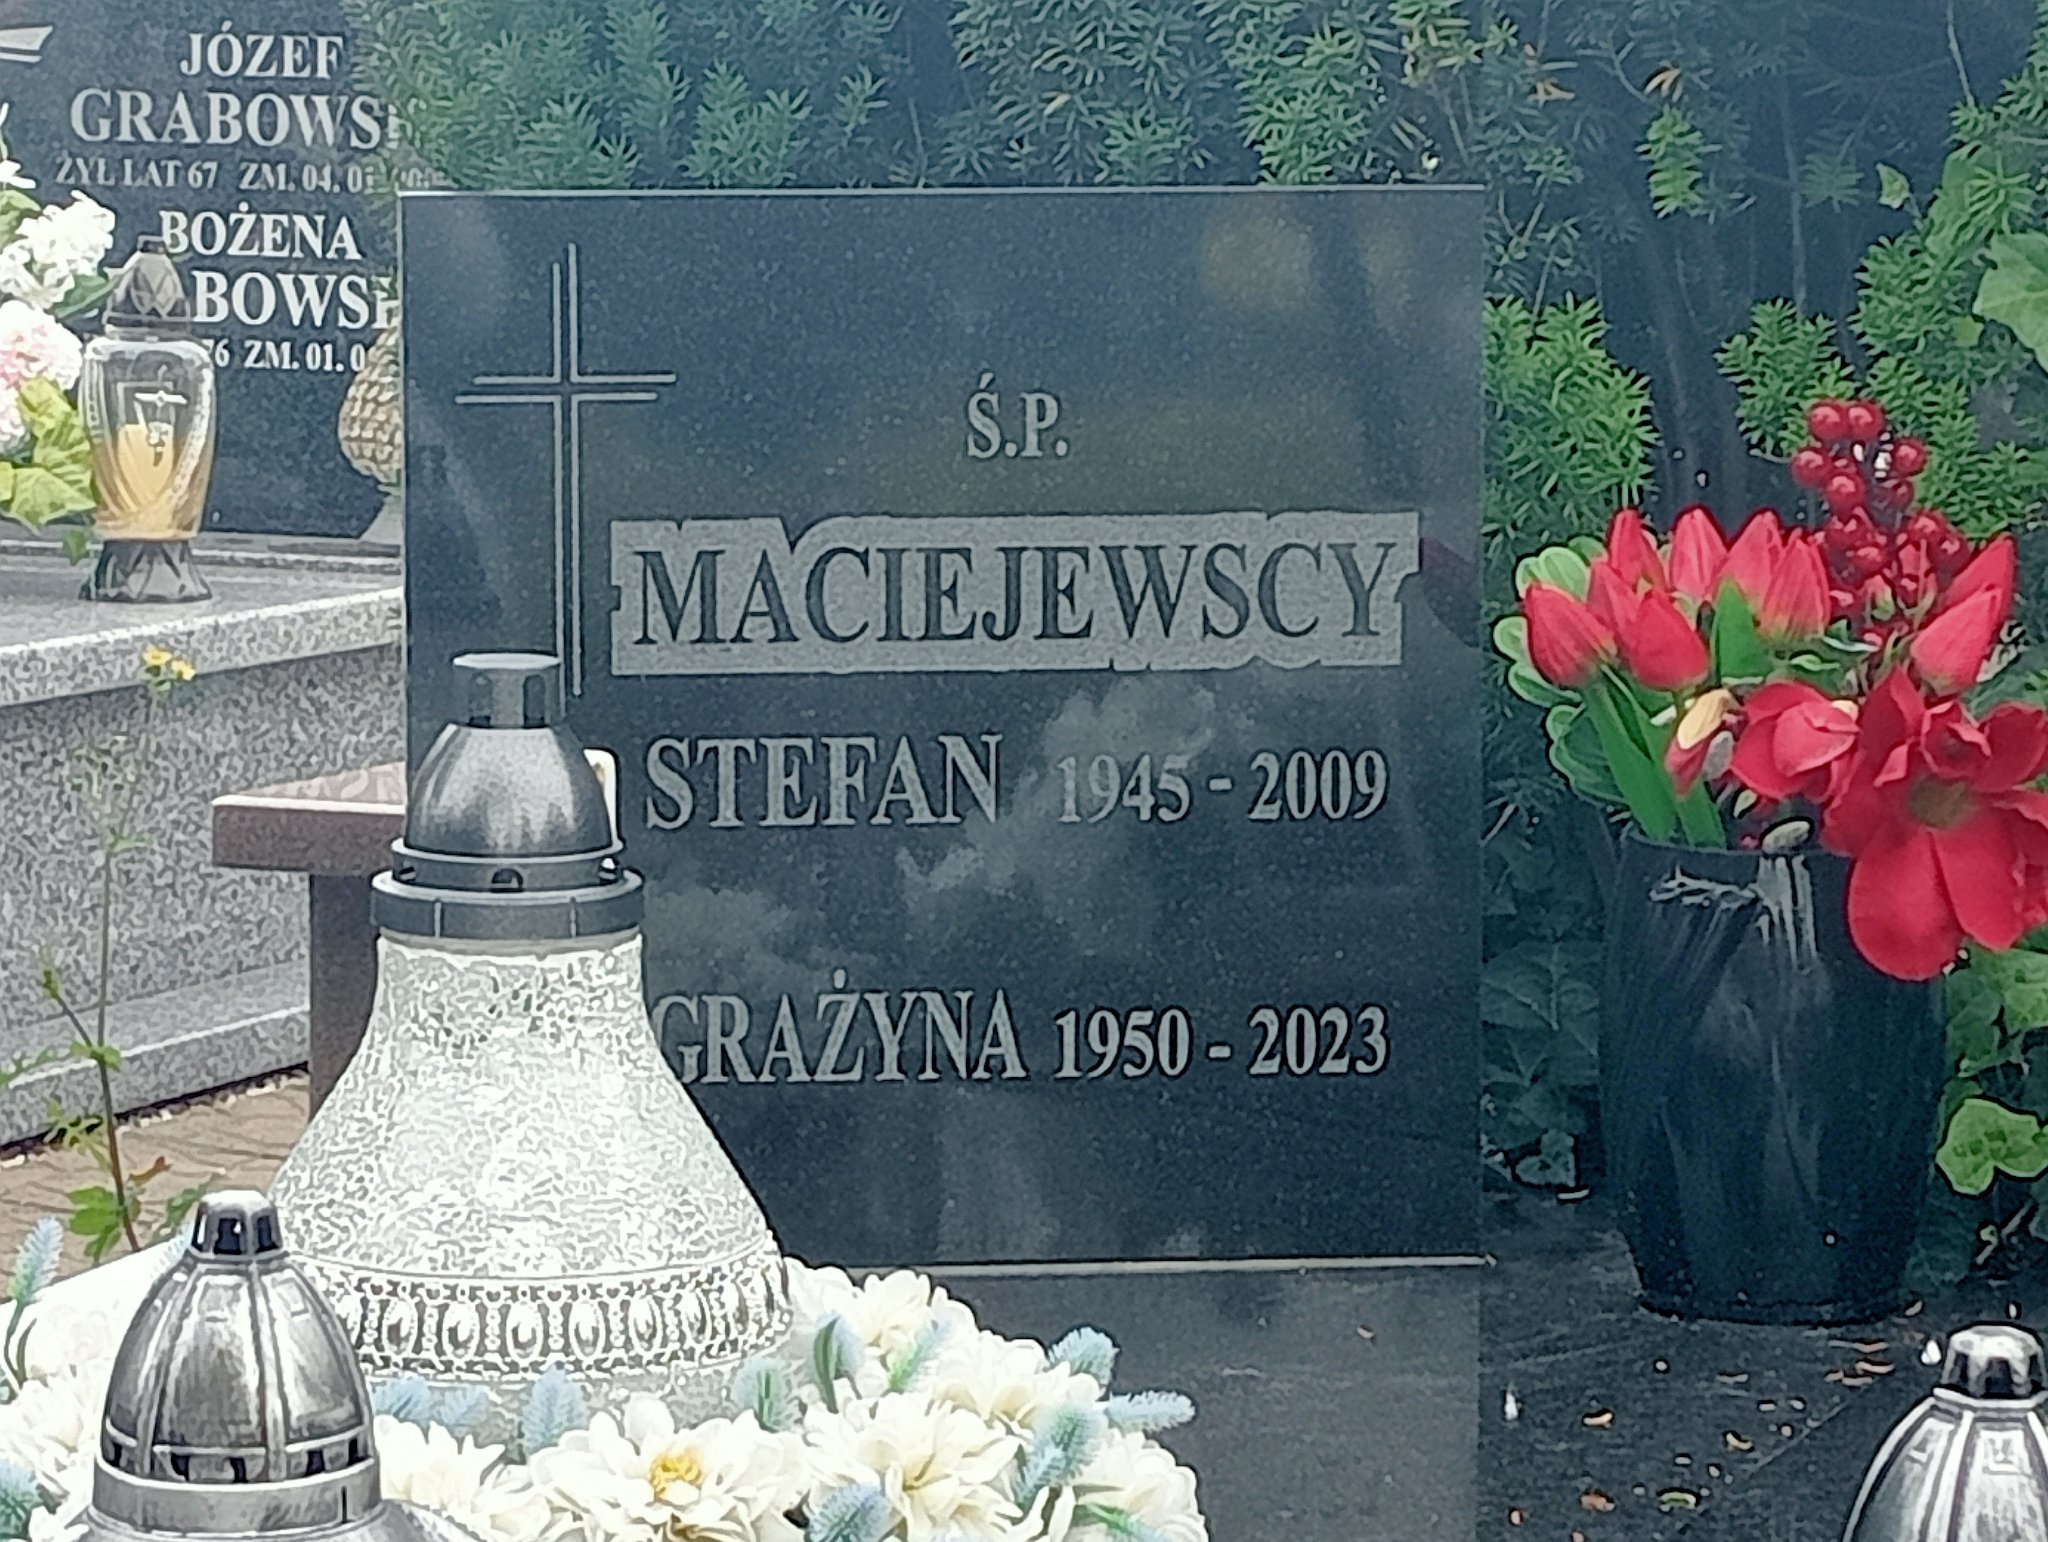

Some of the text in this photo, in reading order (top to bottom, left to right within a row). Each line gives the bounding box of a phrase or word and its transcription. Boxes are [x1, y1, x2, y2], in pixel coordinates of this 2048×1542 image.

[179, 20, 344, 79] JÓZEF
[123, 158, 183, 188] LAT
[187, 160, 218, 189] 67
[159, 201, 362, 261] BOŻENA
[191, 270, 398, 330] BOWS
[965, 371, 1069, 459] Ś.P.
[633, 541, 1399, 645] MACIEJEWSCY
[645, 734, 1388, 830] STEFAN 1945 - 2009
[652, 968, 1388, 1084] GRAŻYNA 1950 - 2023
